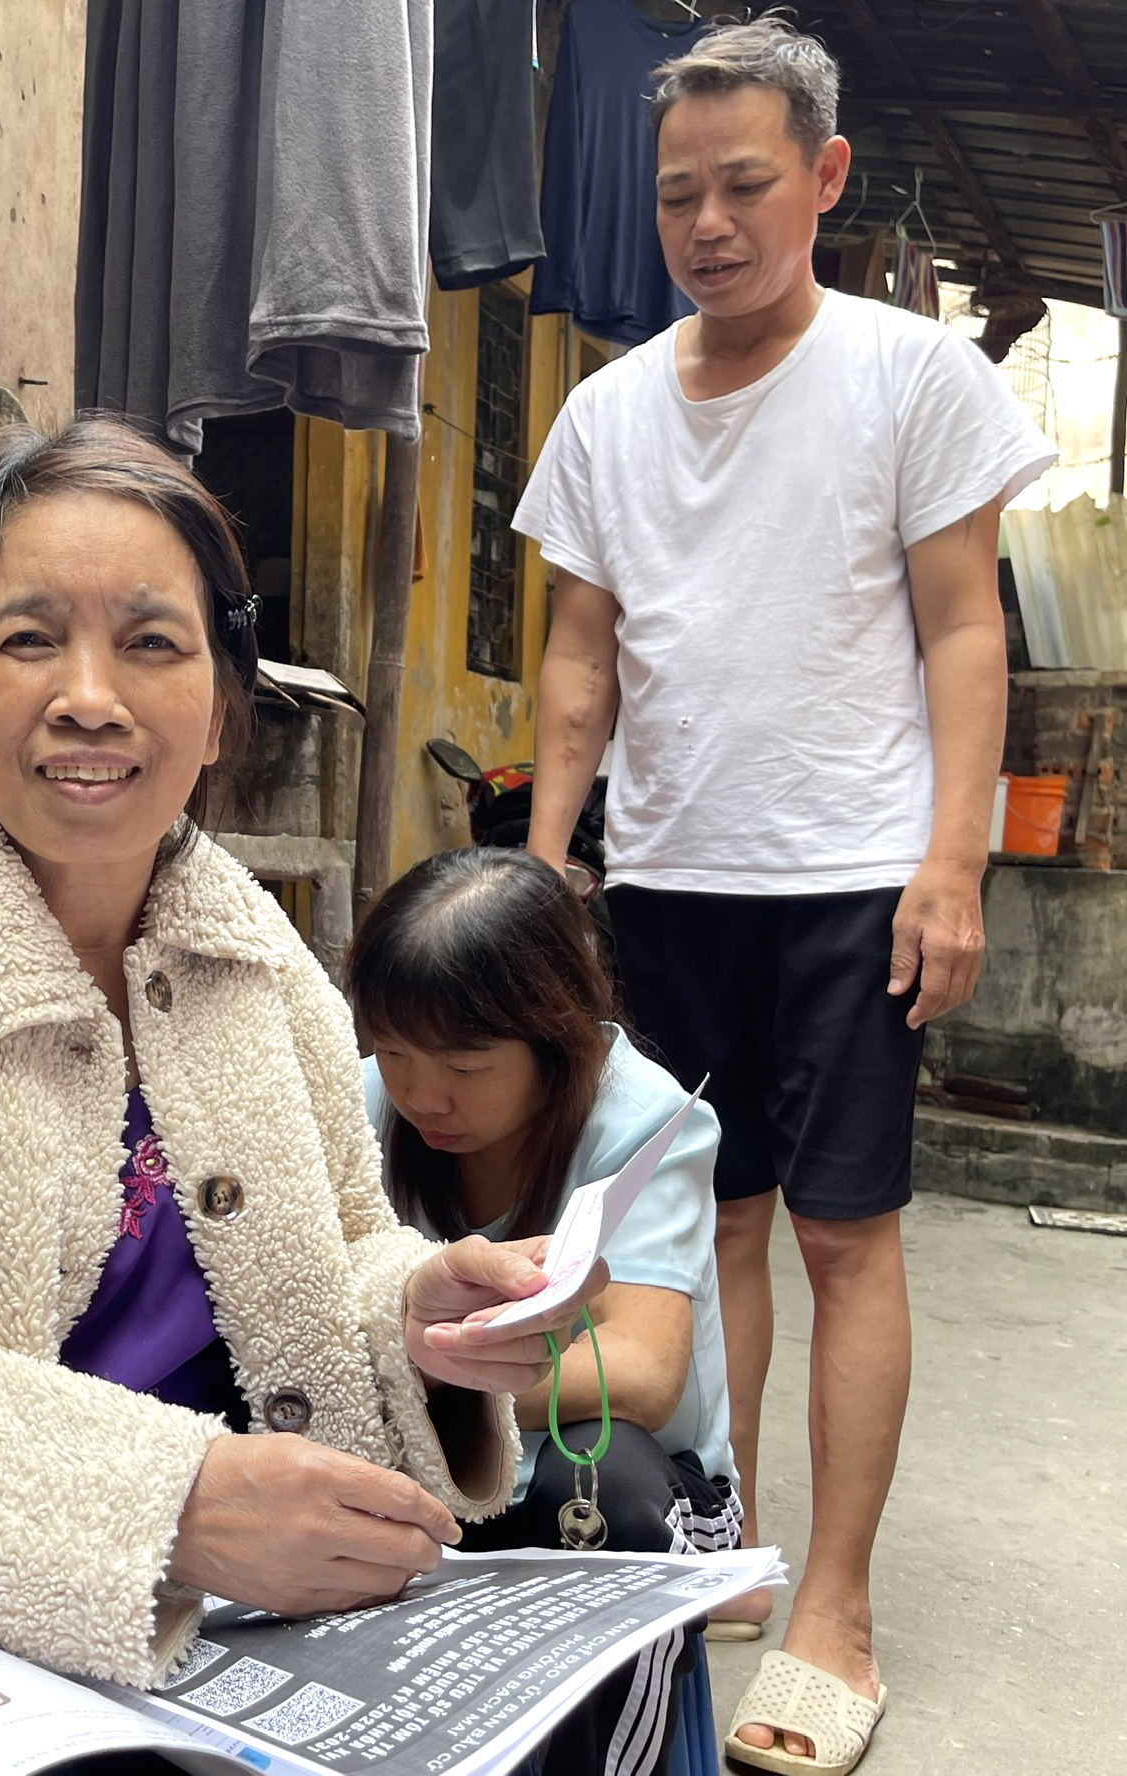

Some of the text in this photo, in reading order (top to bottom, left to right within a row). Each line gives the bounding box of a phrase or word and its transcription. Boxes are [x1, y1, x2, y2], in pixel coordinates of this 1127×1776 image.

[486, 1615, 520, 1631] CÁC
[540, 1607, 589, 1631] CHÍNH
[604, 1617, 640, 1637] BAN
[502, 1631, 545, 1656] THỨC
[575, 1635, 607, 1656] CHỈ
[479, 1657, 507, 1673] VÀ
[545, 1654, 581, 1679] ĐẠO
[418, 1671, 460, 1702] QUỐC
[447, 1634, 585, 1737] PHƯỜNG BẠCH MAI
[517, 1685, 542, 1704] ỦY
[390, 1701, 422, 1722] HỘI
[427, 1699, 452, 1718] SỬ
[483, 1703, 519, 1729] BAN
[307, 1702, 393, 1753] 2026-2031
[348, 1721, 394, 1749] KHÓA
[390, 1717, 430, 1742] TÓM
[317, 1747, 351, 1761] XVI
[360, 1741, 395, 1760] TẮT
[426, 1752, 452, 1772] CỬ
